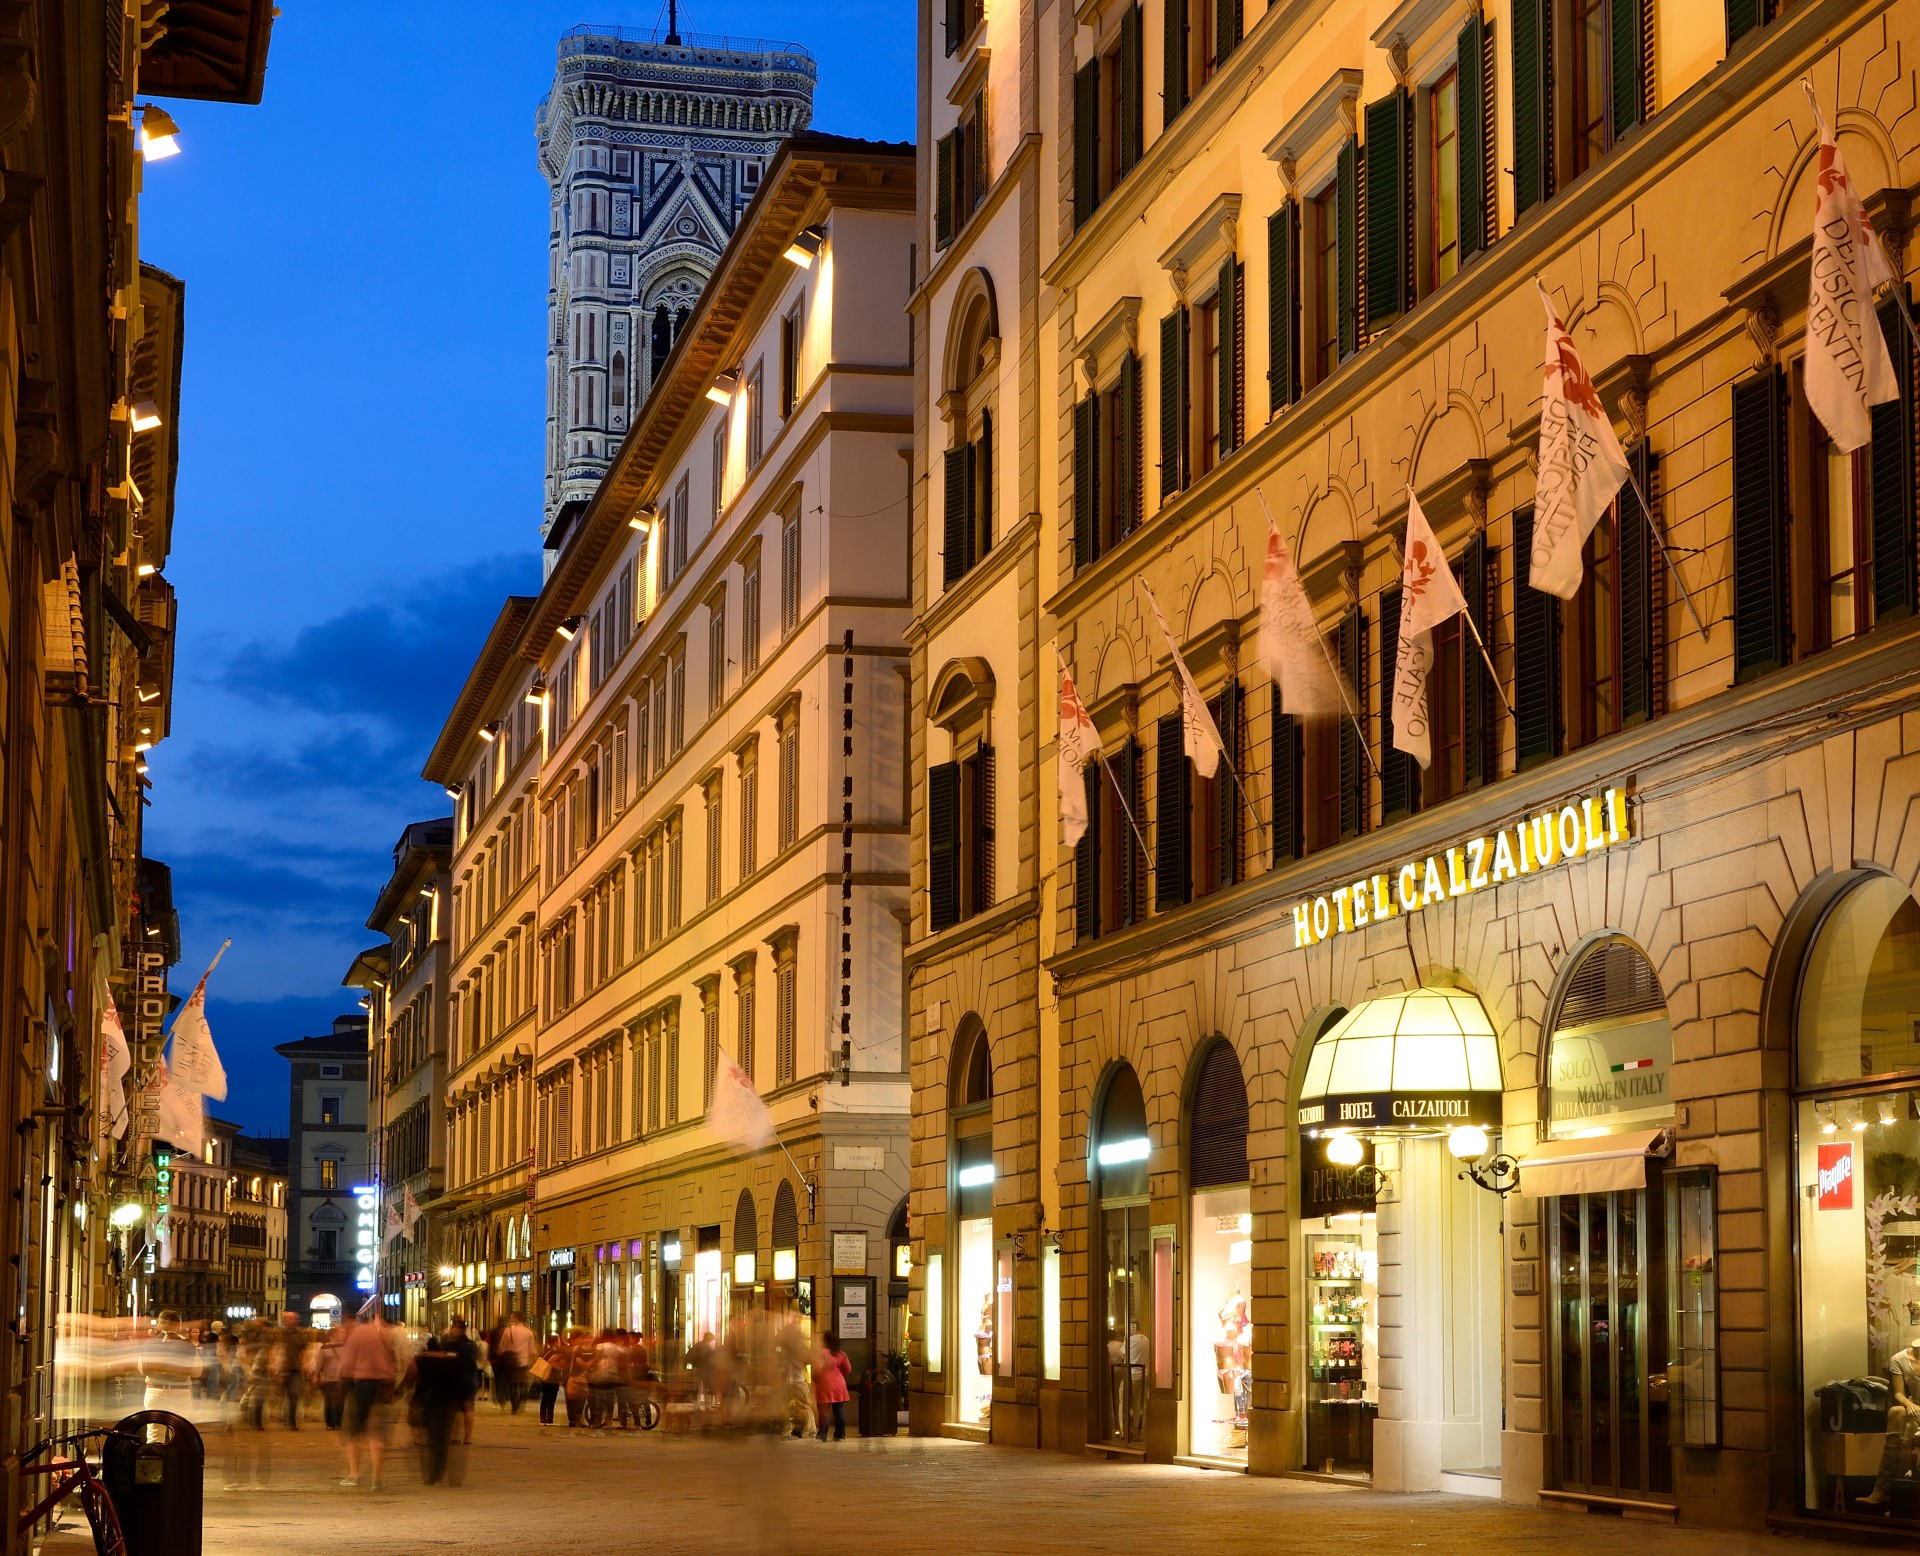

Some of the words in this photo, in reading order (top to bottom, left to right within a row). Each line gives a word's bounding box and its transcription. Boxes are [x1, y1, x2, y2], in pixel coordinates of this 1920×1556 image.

[1292, 873, 1399, 948] HOTEL
[1398, 787, 1631, 911] CALZAIUOLI
[138, 952, 164, 1181] PROFUMERIA
[1559, 1058, 1592, 1082] SOLO
[1577, 1081, 1612, 1105] MADE
[1613, 1077, 1629, 1100] IN
[1630, 1072, 1665, 1098] ITALY
[1339, 1101, 1376, 1120] HOTEL
[1392, 1100, 1470, 1118] CALZAIUOLI
[1818, 1154, 1851, 1199] Playlife
[357, 1194, 375, 1281] OMEGA
[1519, 1231, 1527, 1251] 6
